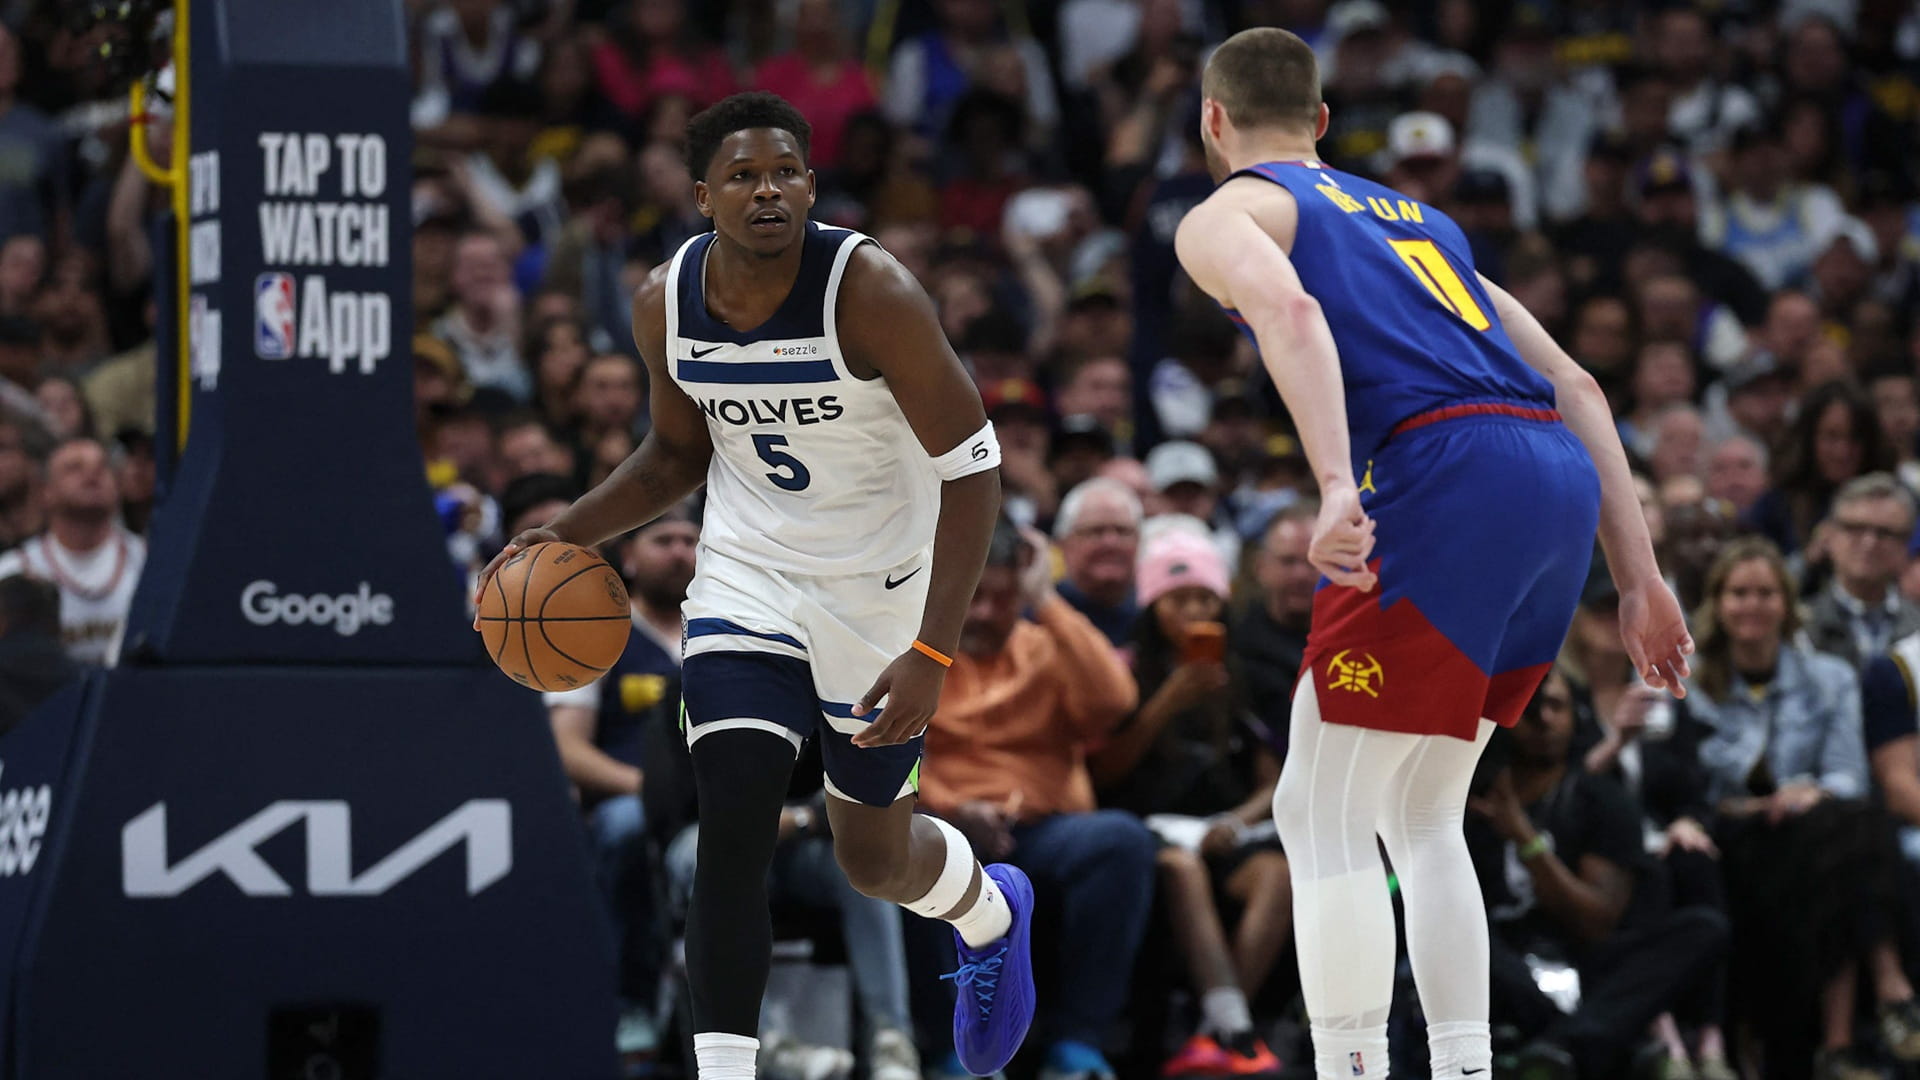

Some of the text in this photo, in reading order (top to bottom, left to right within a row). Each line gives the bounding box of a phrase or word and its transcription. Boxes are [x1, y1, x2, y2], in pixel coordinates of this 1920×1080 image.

[258, 133, 330, 196] TAP
[335, 133, 386, 198] TO
[259, 202, 389, 266] WATCH
[1385, 237, 1492, 332] 0
[298, 274, 391, 374] App
[781, 343, 818, 356] sezzle
[698, 395, 844, 425] WOLVES
[751, 433, 811, 492] 5
[971, 440, 989, 462] 5
[240, 579, 394, 636] Google
